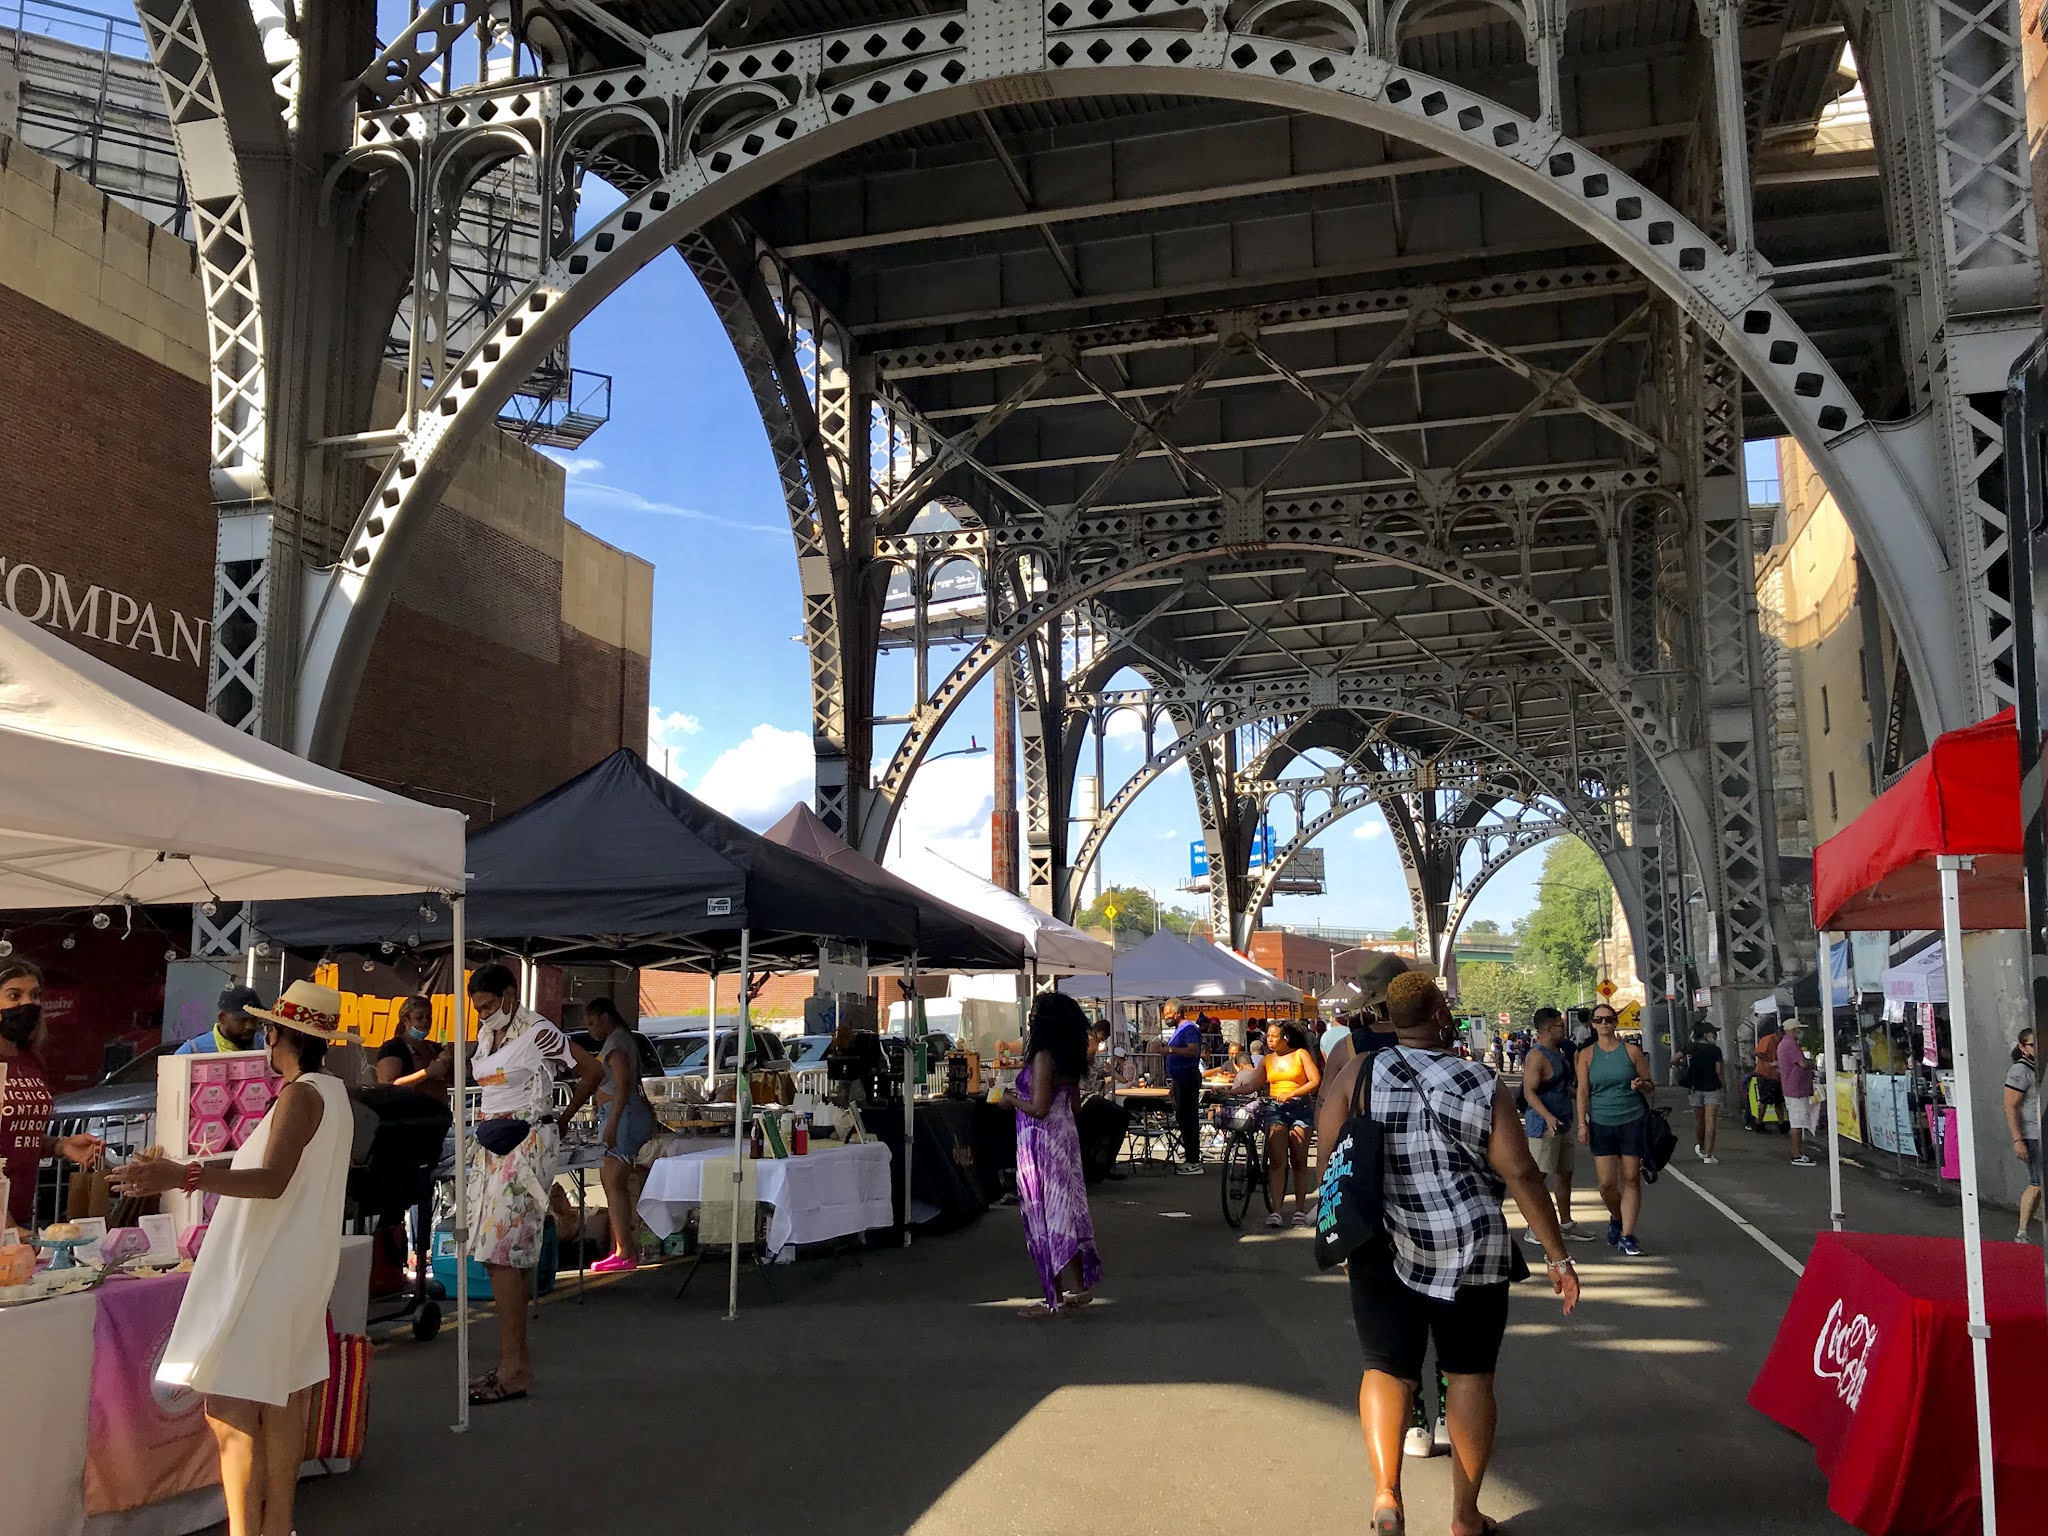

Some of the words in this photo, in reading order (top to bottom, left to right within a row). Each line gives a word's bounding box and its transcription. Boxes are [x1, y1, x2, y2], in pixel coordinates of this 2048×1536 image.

[0, 556, 214, 668] OMPAN
[2, 1104, 53, 1117] ONTARI
[9, 1120, 46, 1132] HURO
[14, 1136, 40, 1148] ERIE
